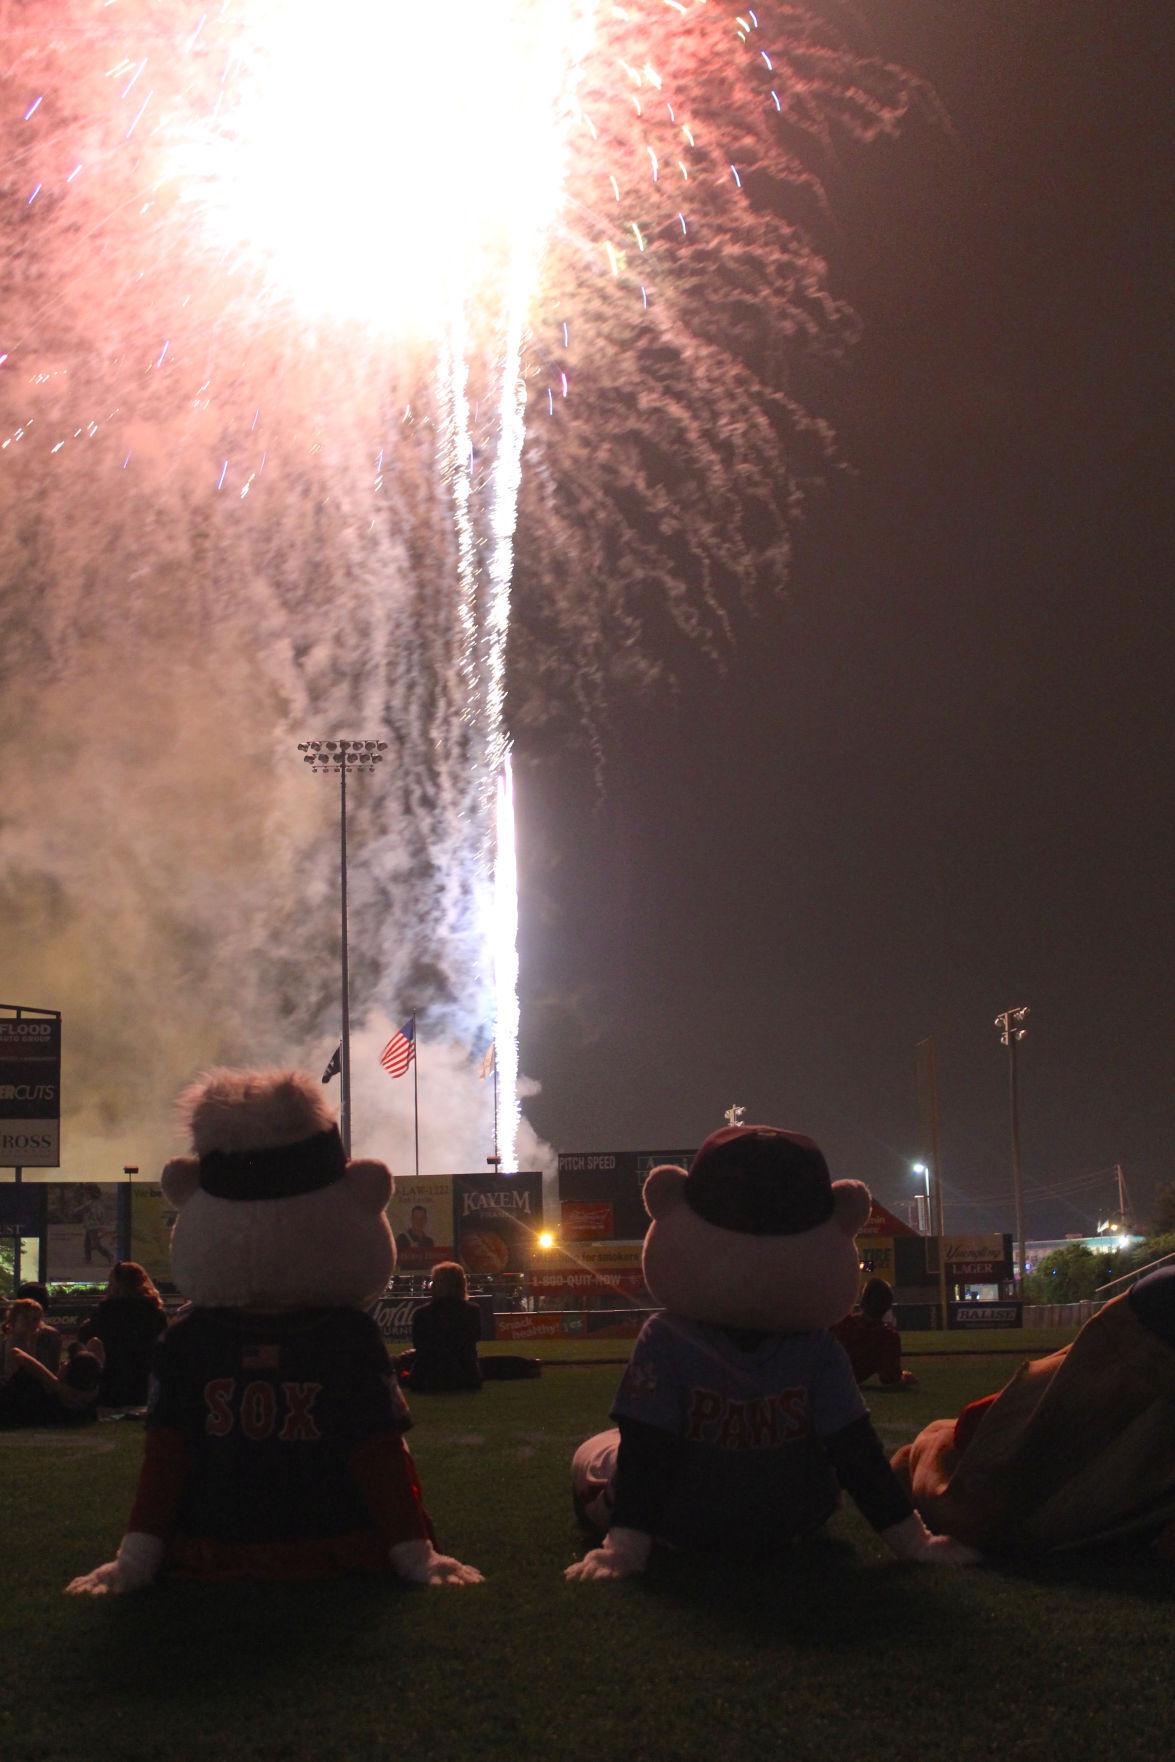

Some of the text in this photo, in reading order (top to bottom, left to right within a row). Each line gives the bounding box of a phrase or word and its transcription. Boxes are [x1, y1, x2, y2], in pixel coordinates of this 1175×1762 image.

[0, 1023, 52, 1036] FLOOD
[559, 1155, 616, 1170] PITCH SPEED
[462, 1190, 531, 1217] KAYEM
[952, 1263, 993, 1275] LAGER
[203, 1377, 324, 1441] SOX
